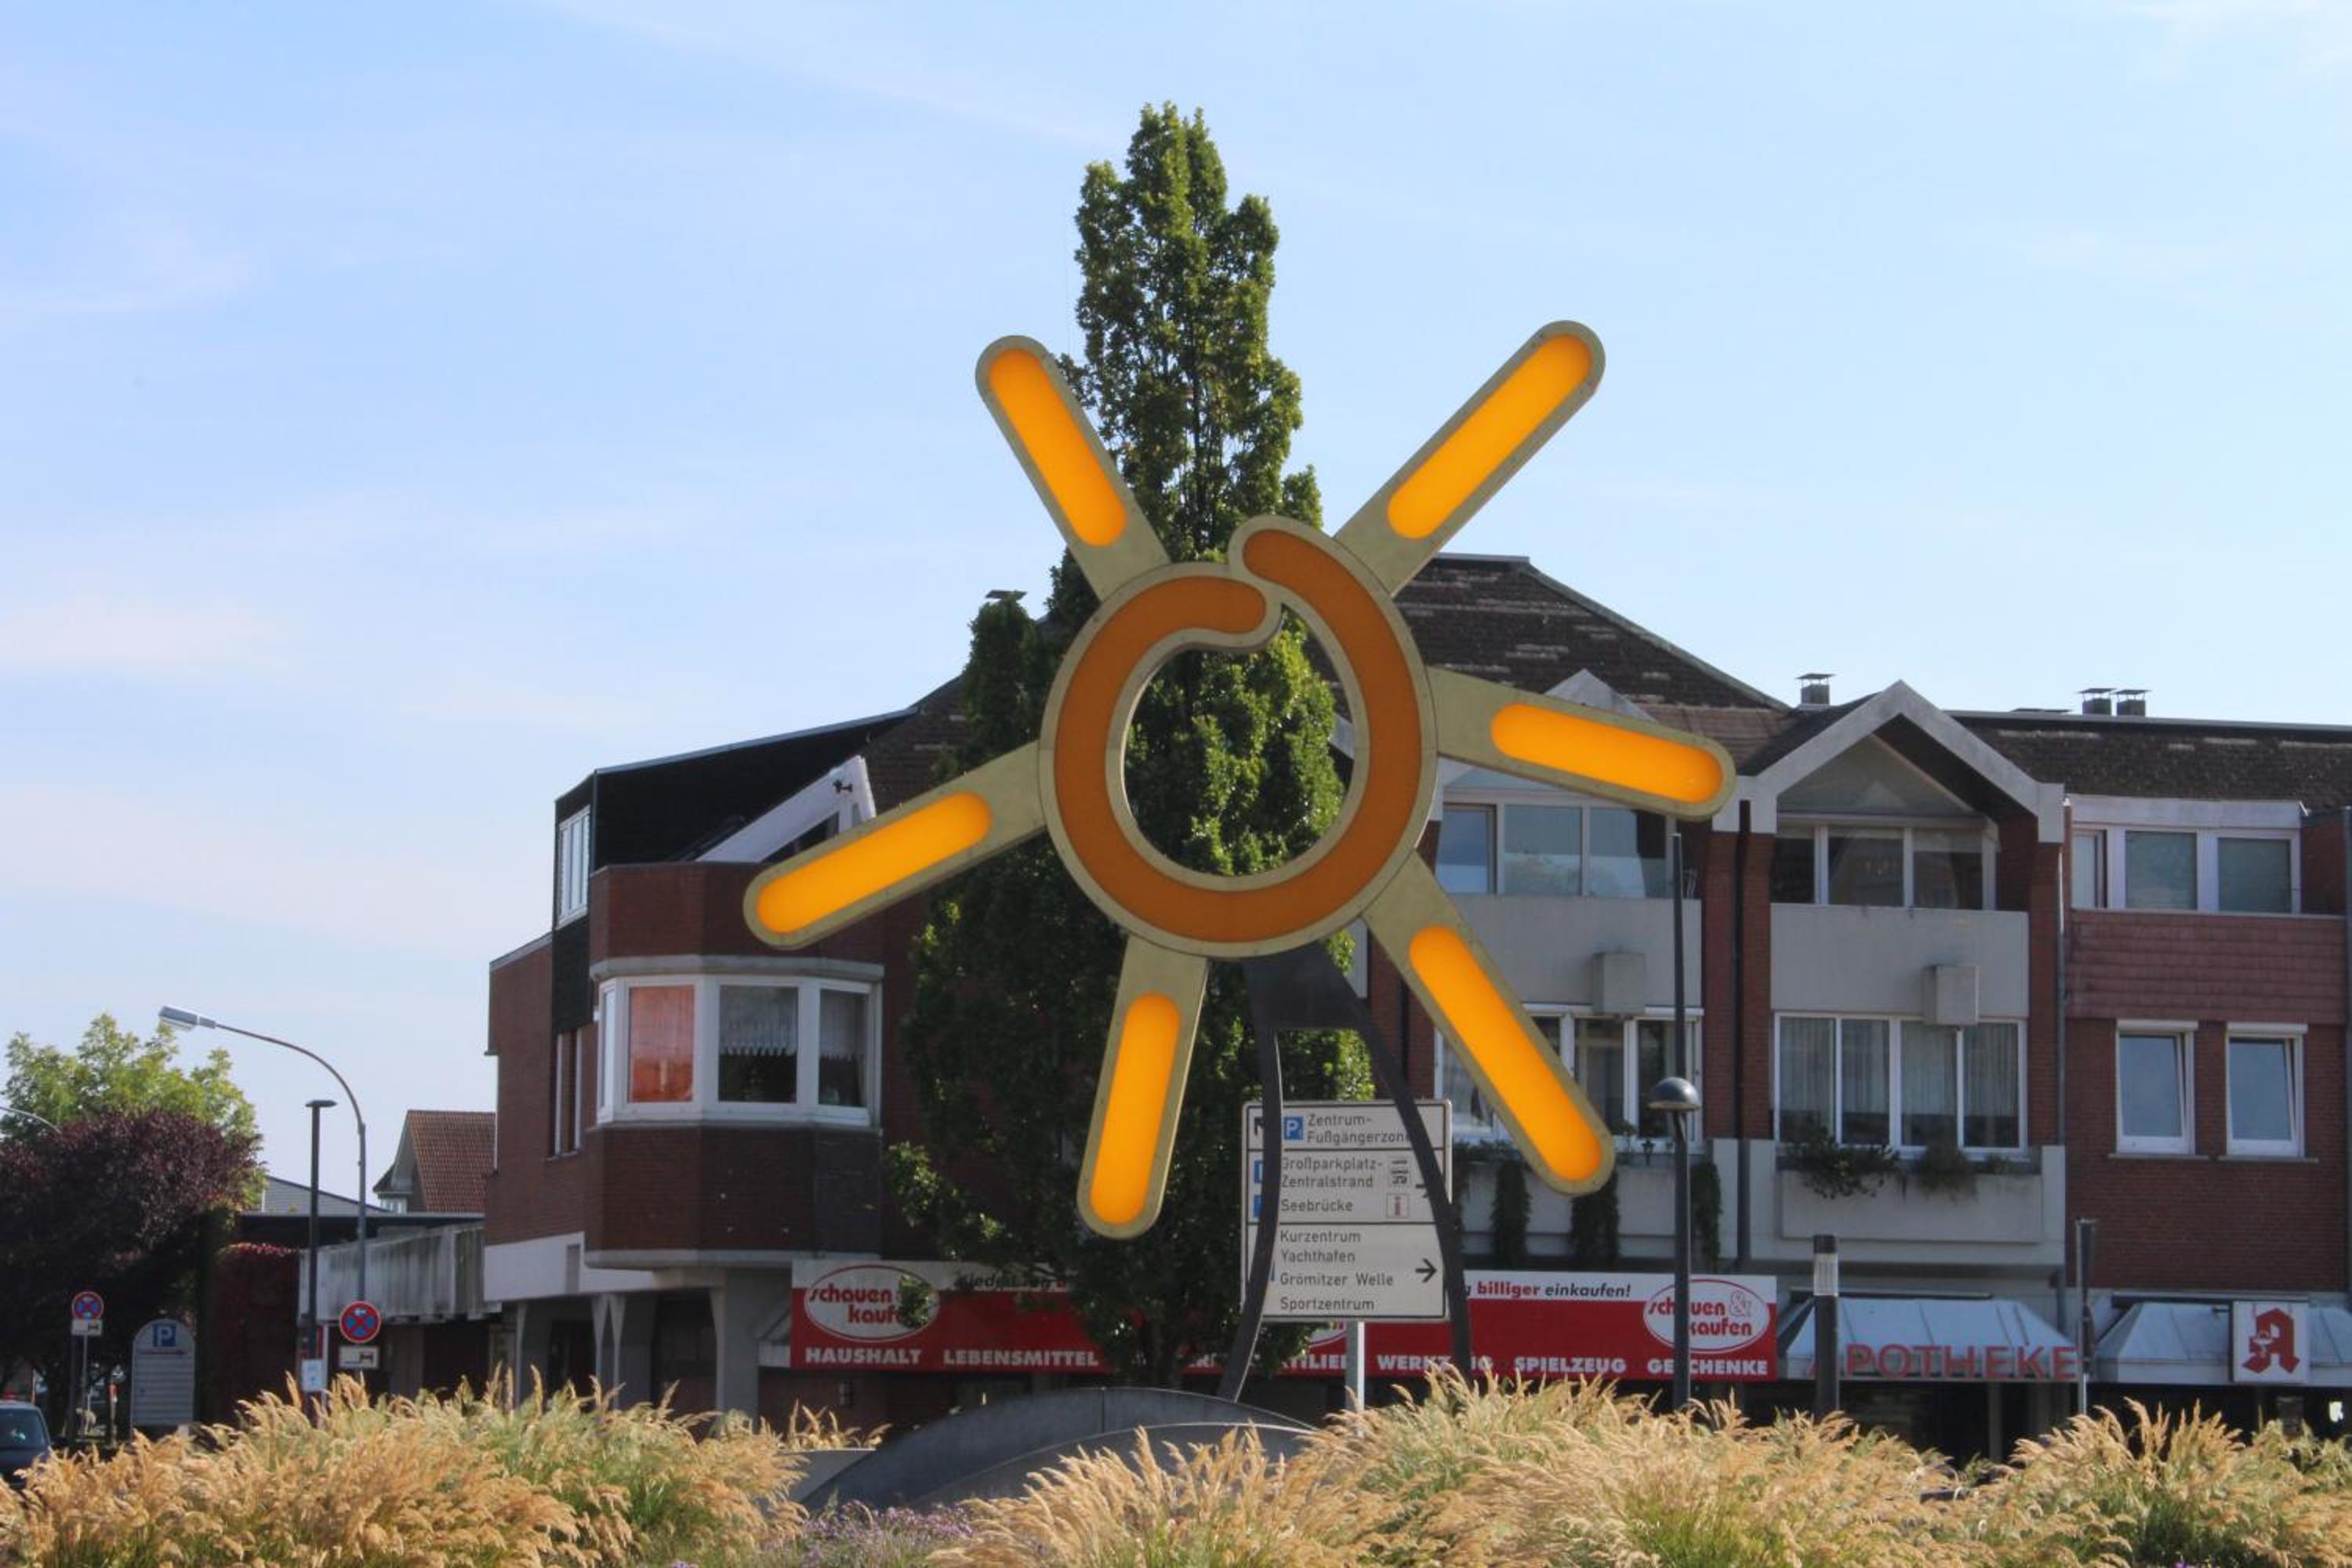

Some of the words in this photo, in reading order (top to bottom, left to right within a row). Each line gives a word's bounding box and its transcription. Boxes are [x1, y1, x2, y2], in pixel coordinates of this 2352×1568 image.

[1307, 1113, 1371, 1127] Zentrum-
[1281, 1174, 1374, 1188] Zentralstrand
[1281, 1198, 1353, 1212] Seebrücke
[1279, 1230, 1361, 1243] Kurzentrum
[1280, 1250, 1356, 1263] Yachthafen
[1279, 1272, 1348, 1286] Grömitzer
[1356, 1272, 1394, 1286] Welle
[808, 1283, 892, 1304] schauen
[1477, 1281, 1541, 1298] billiger
[1544, 1283, 1632, 1298] einkaufen!
[1279, 1296, 1375, 1311] Sportzentrum
[1648, 1297, 1726, 1316] schuen
[804, 1346, 923, 1364] HAUSHALT
[943, 1349, 1098, 1367] LEBENSMITTEL
[1514, 1356, 1627, 1375] SPIELZEUG
[1646, 1358, 1768, 1376] GECHENKE
